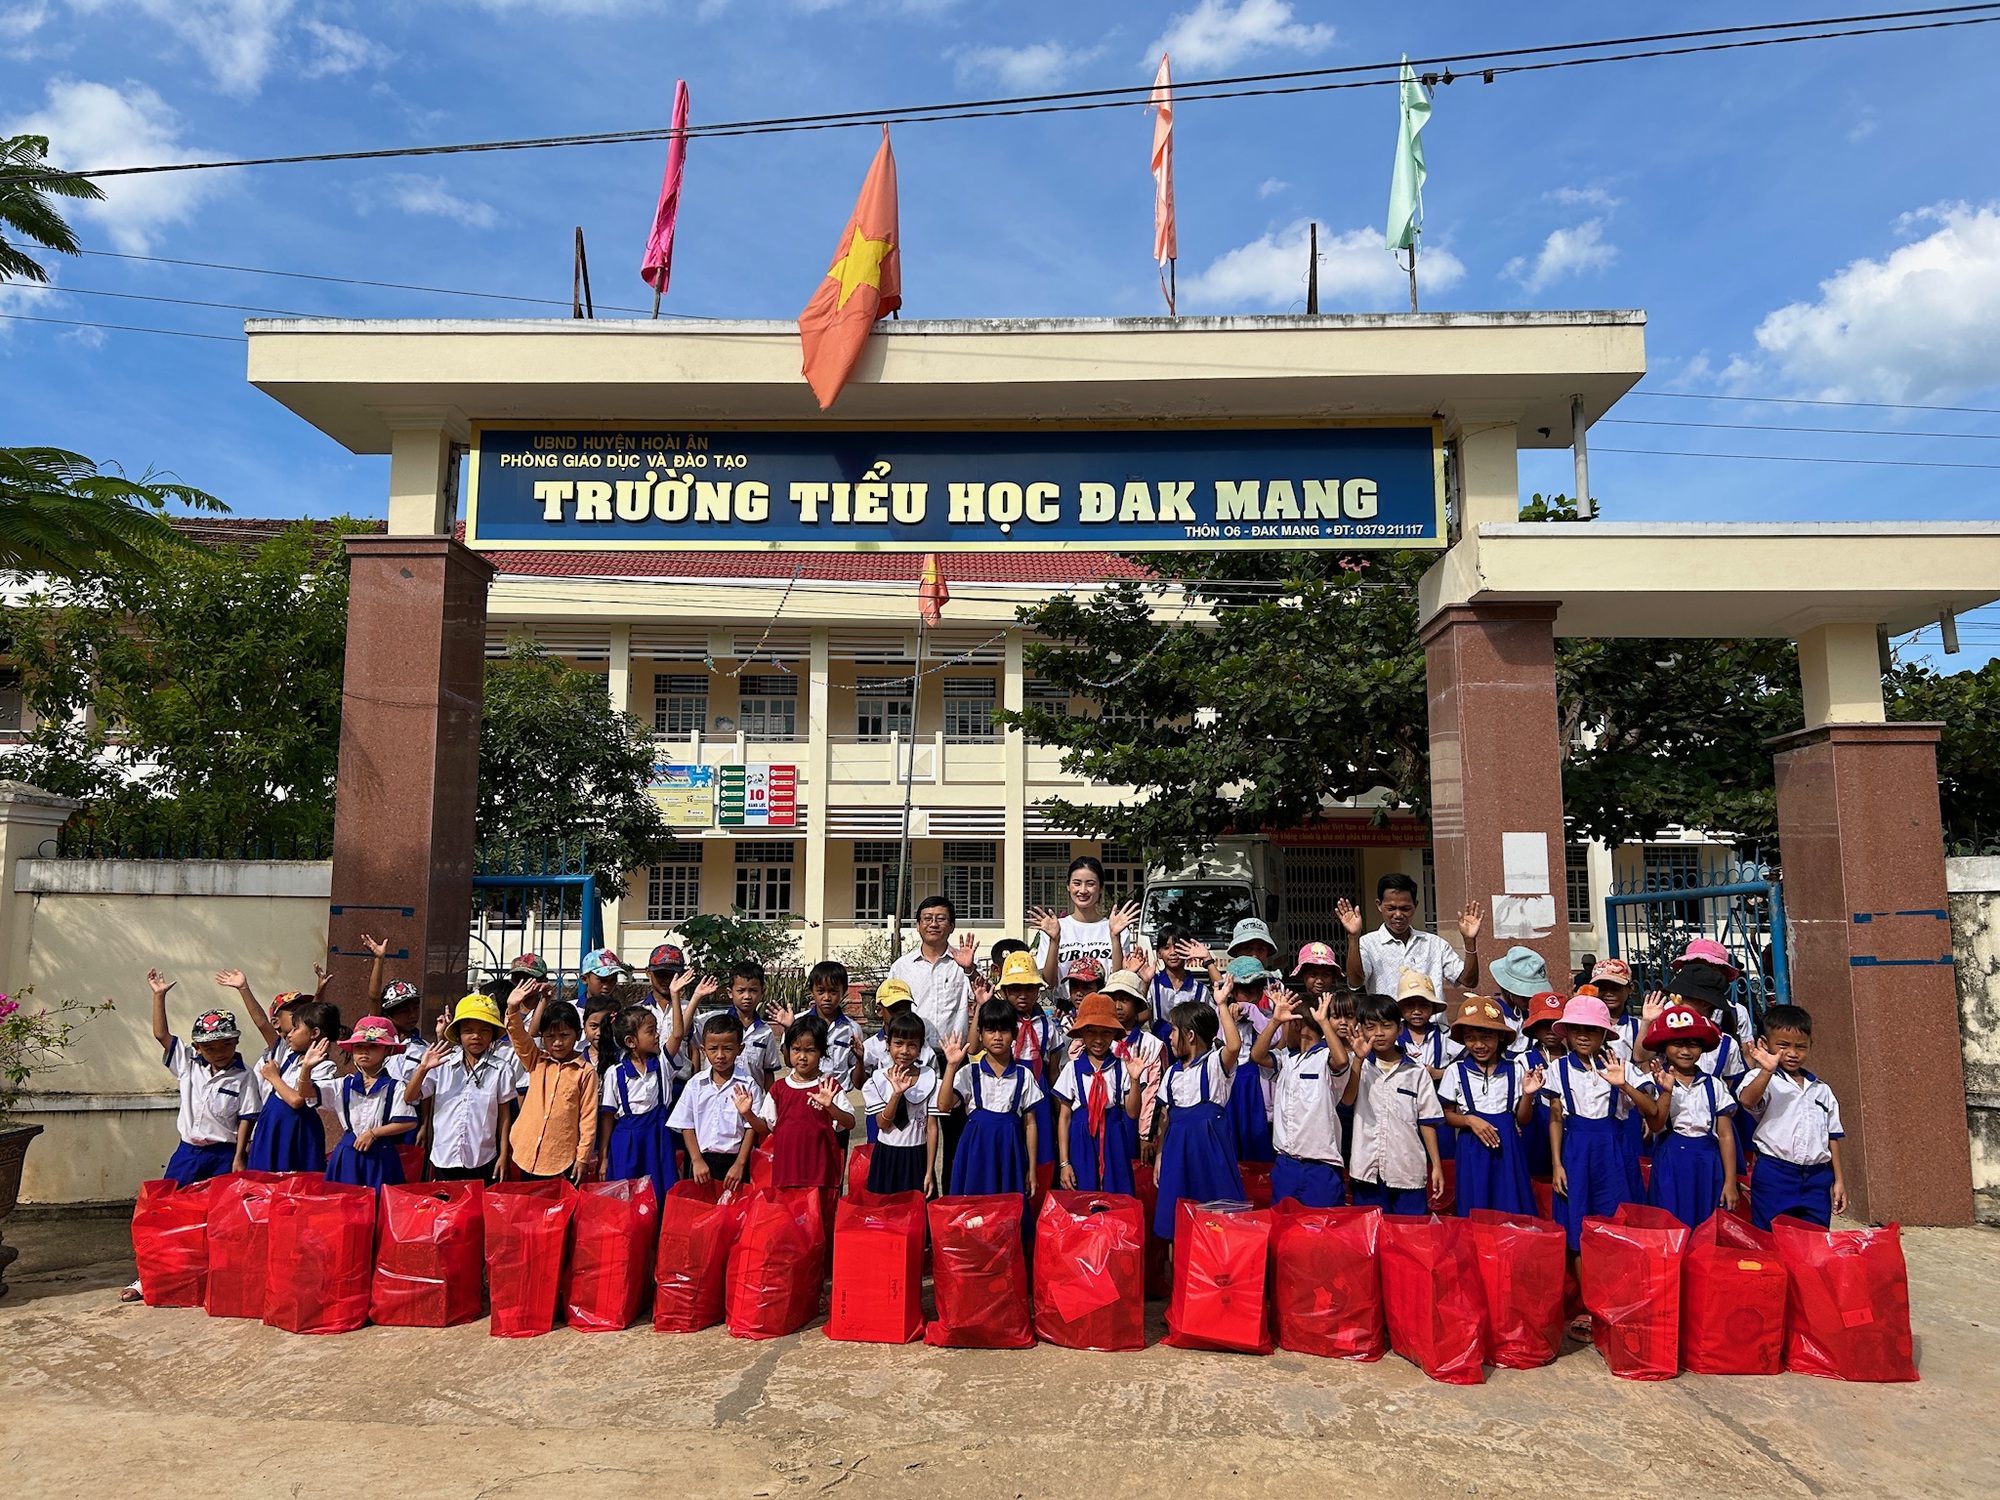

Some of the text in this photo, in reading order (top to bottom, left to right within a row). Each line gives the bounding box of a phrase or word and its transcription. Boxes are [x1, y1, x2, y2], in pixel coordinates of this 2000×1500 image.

[533, 433, 709, 453] UBND HUYỆN HOÀI ÂN
[500, 450, 748, 471] PHÒNG GIÁO DỤC VÀ ĐÀO TẠO
[533, 461, 1378, 533] TRƯỜNG TIỂU HỌC ĐAK MANG
[1184, 523, 1220, 537] THÔN
[1251, 525, 1279, 537] ĐAK
[1281, 525, 1320, 536] MANG
[750, 789, 765, 801] 10
[1060, 941, 1086, 950] EAUTY
